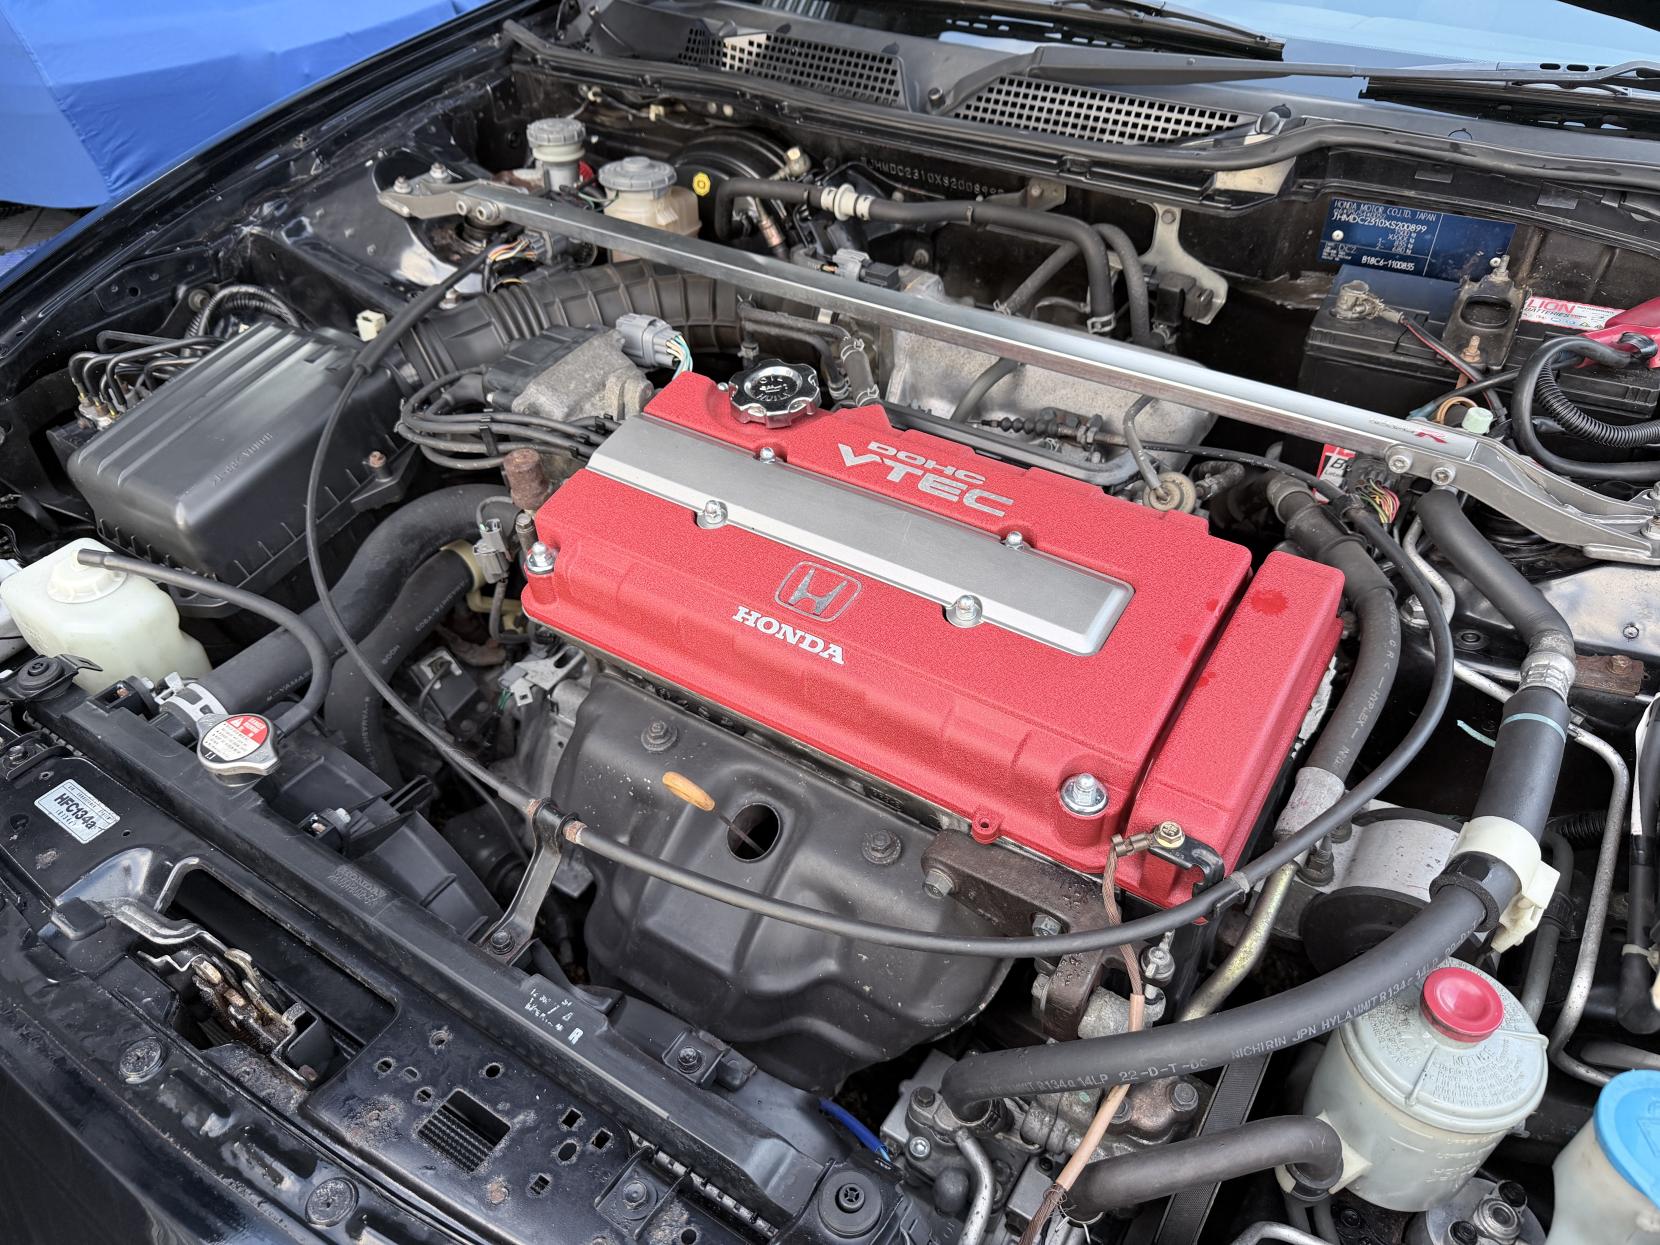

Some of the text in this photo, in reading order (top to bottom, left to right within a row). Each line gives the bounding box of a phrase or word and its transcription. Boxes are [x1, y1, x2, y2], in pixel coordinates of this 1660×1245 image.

[1334, 200, 1357, 210] HONDA
[1360, 203, 1385, 214] MOTOR
[1414, 211, 1436, 221] JAPAN
[1526, 298, 1576, 314] LION
[837, 443, 1014, 517] VTEC
[867, 441, 986, 484] DOHC
[732, 605, 846, 665] HONDA
[54, 792, 97, 830] HFC134a
[1231, 1035, 1287, 1060] NICHIRIN
[1292, 1024, 1317, 1042] JPN
